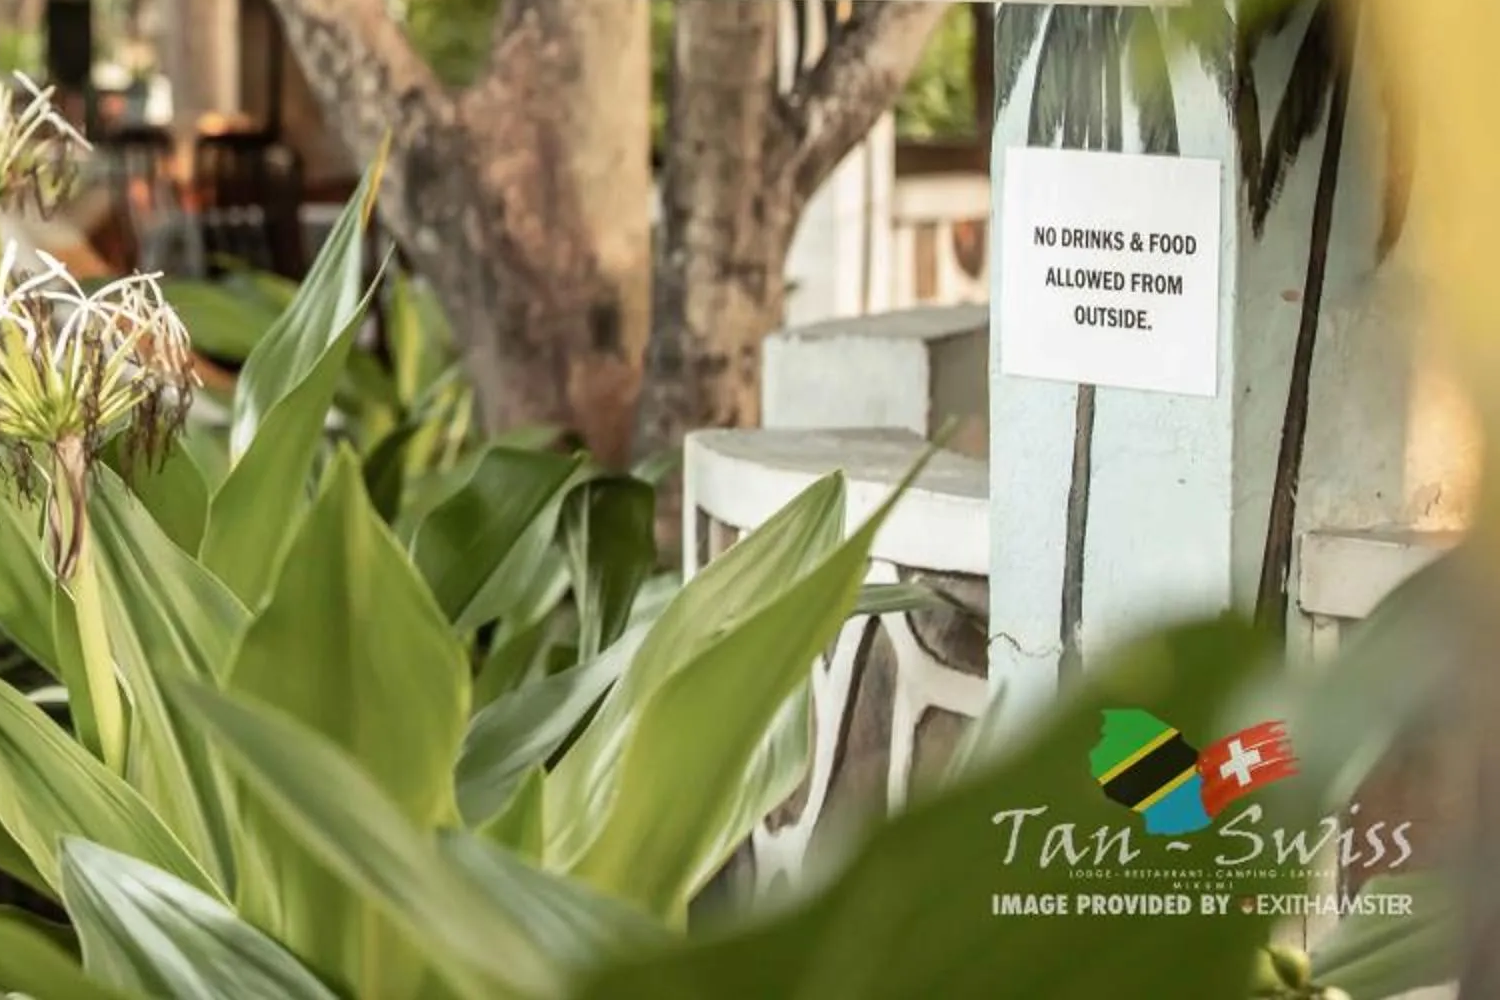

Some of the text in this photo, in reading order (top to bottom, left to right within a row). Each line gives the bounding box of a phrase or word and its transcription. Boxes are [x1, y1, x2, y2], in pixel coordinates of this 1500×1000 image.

[1034, 226, 1197, 255] NO DRINKS & FOOD
[1045, 267, 1183, 295] ALLOWED FROM
[1074, 305, 1152, 330] OUTSIDE.
